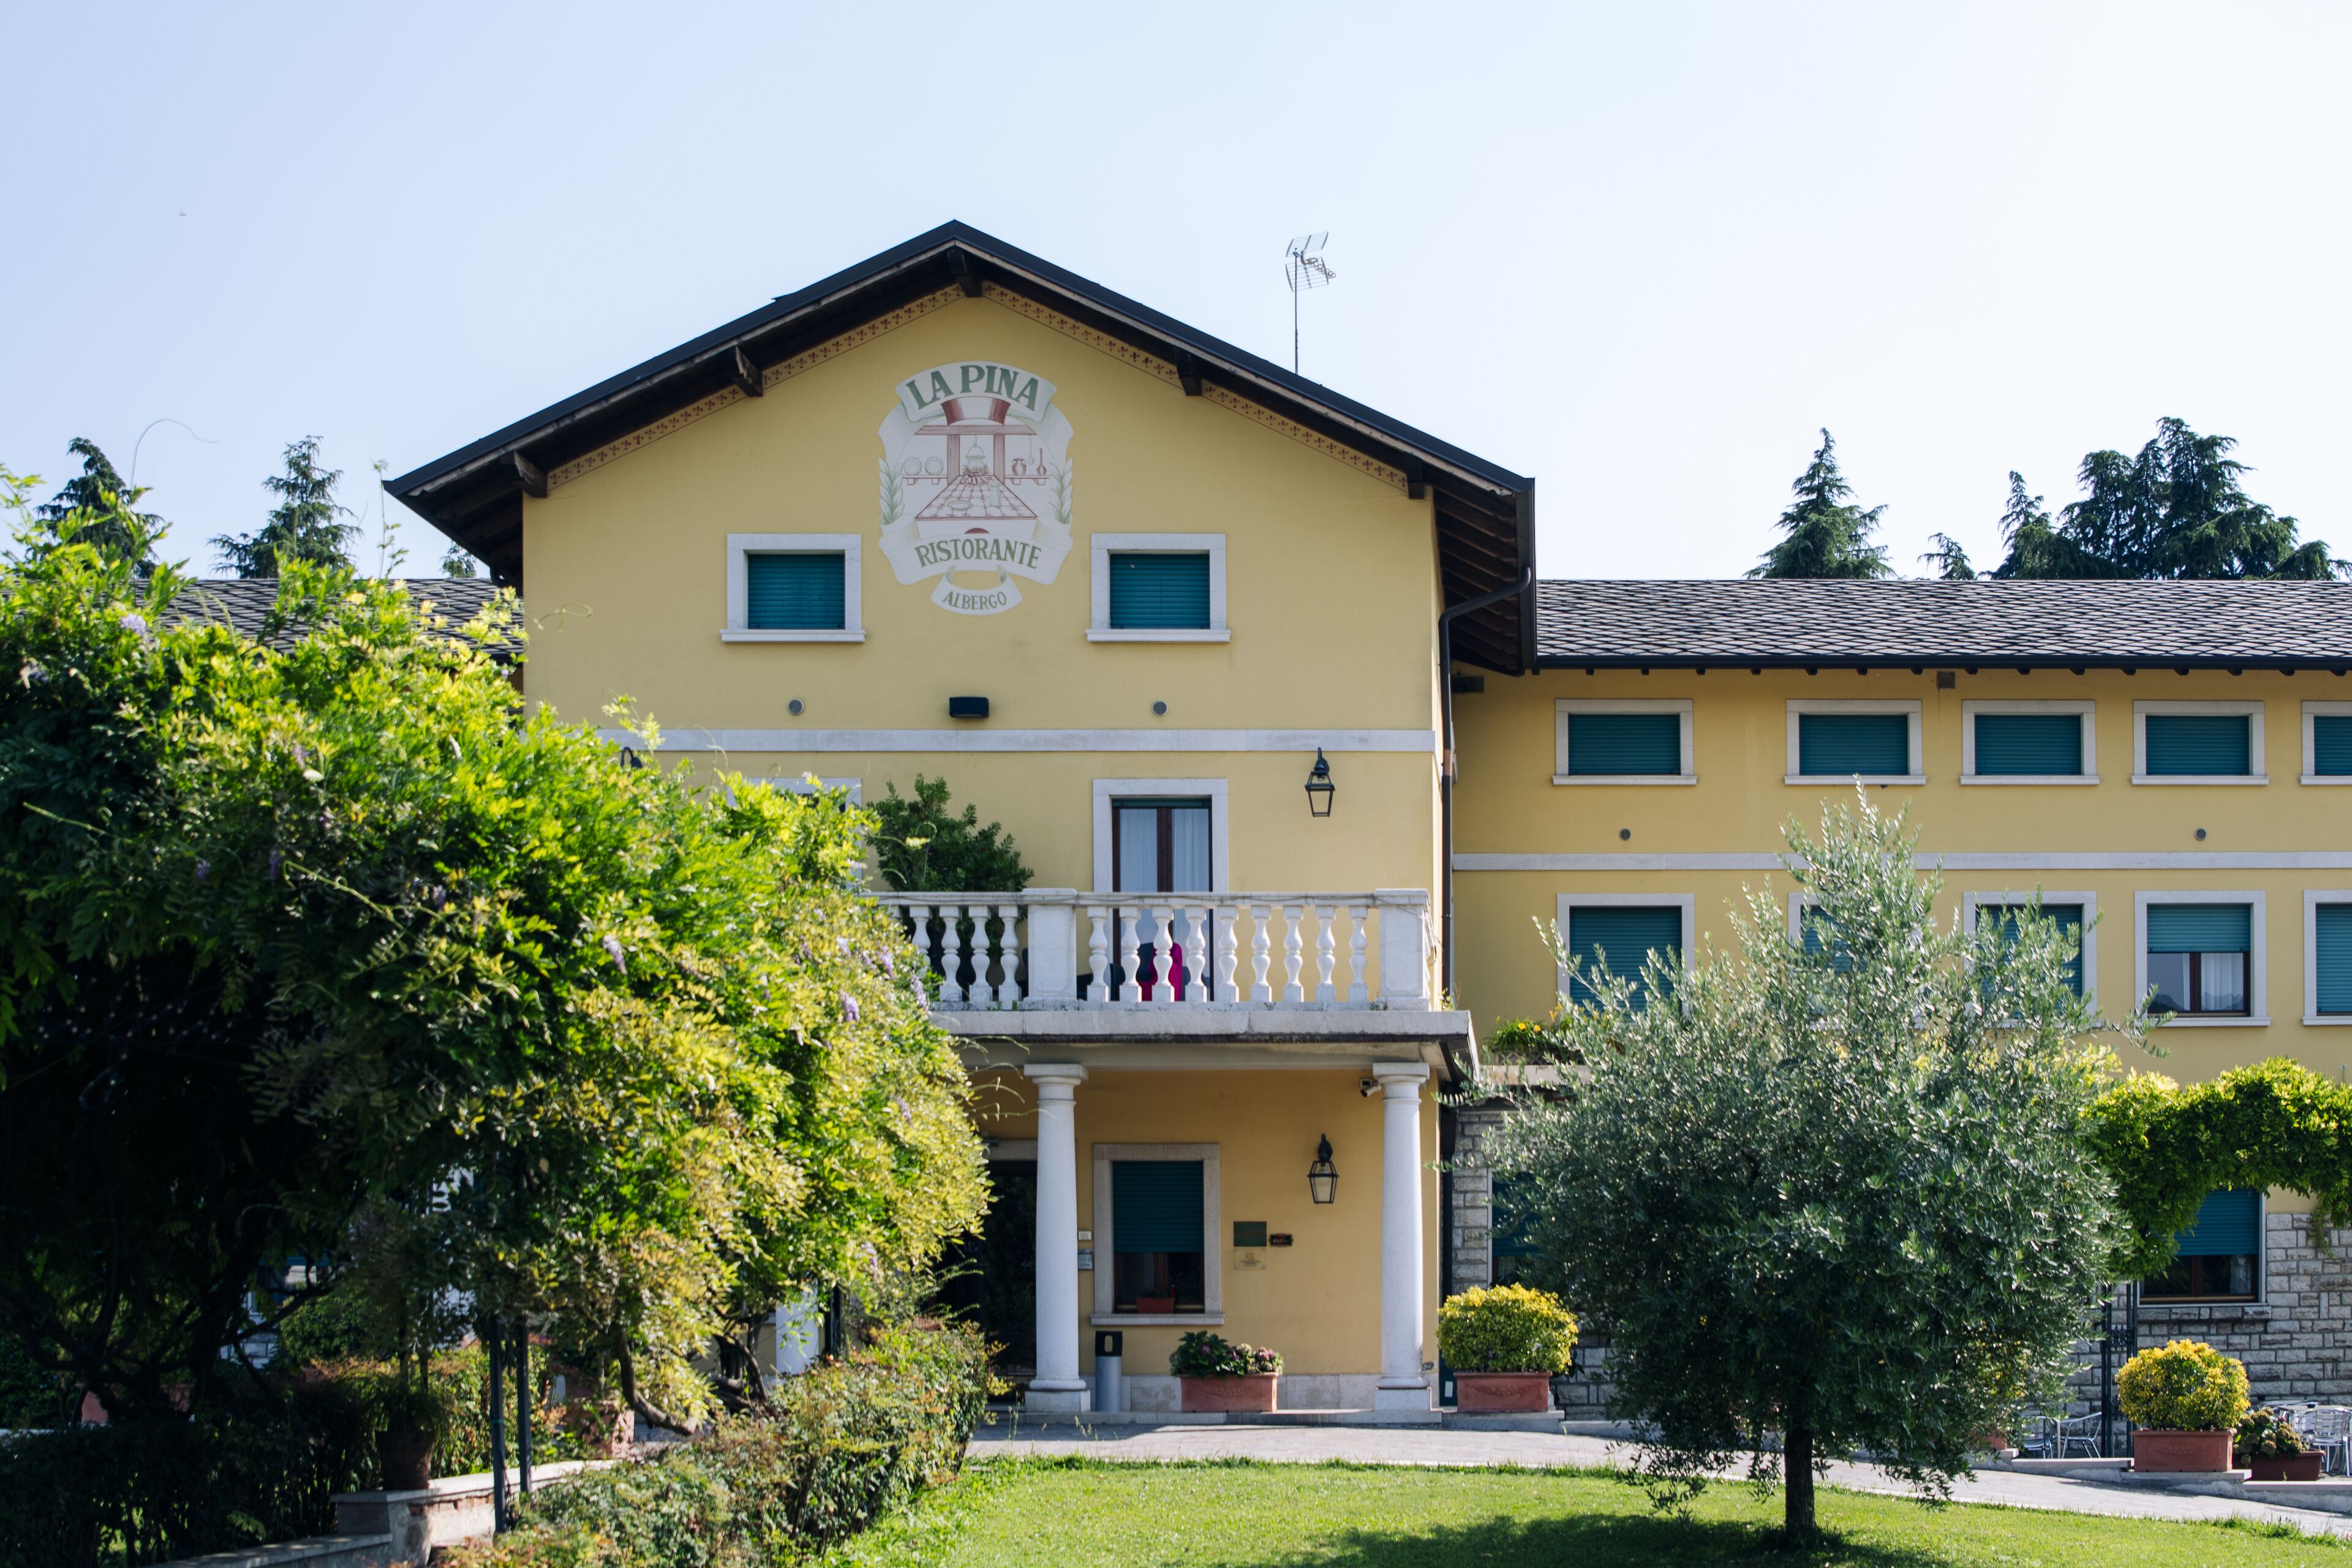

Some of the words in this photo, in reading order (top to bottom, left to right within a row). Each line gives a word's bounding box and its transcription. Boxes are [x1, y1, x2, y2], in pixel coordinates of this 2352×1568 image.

[905, 371, 955, 410] LA
[960, 365, 1039, 412] PINA
[914, 538, 1042, 570] RISTORANTE
[942, 591, 1007, 611] ALBERGO
